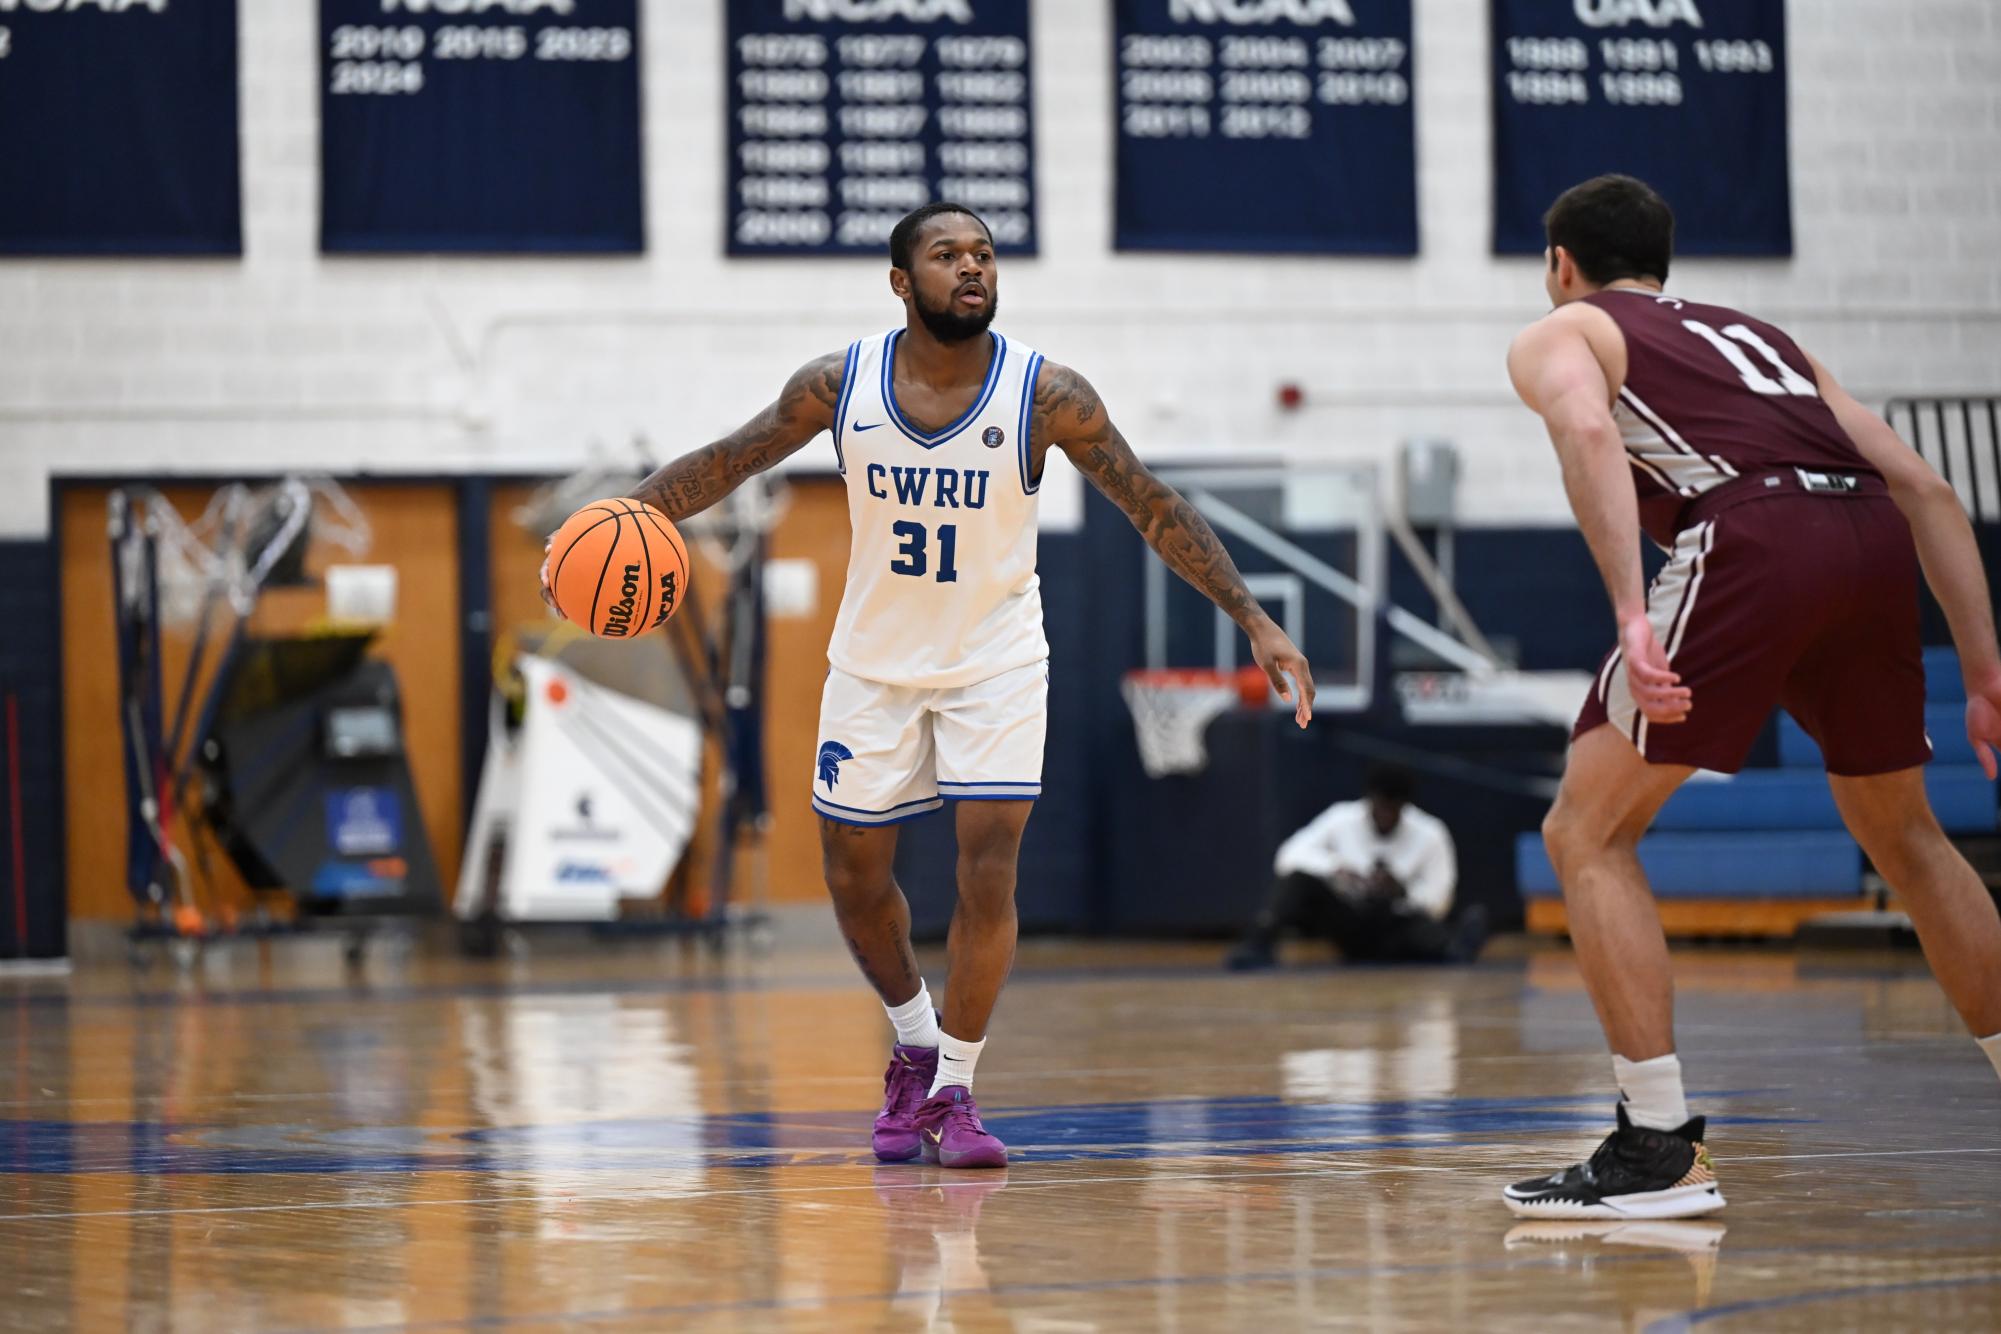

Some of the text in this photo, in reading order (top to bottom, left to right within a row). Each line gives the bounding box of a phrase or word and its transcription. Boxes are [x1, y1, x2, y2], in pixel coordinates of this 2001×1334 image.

[867, 463, 989, 509] CWRU
[891, 520, 957, 582] 31
[602, 565, 640, 636] Wilson
